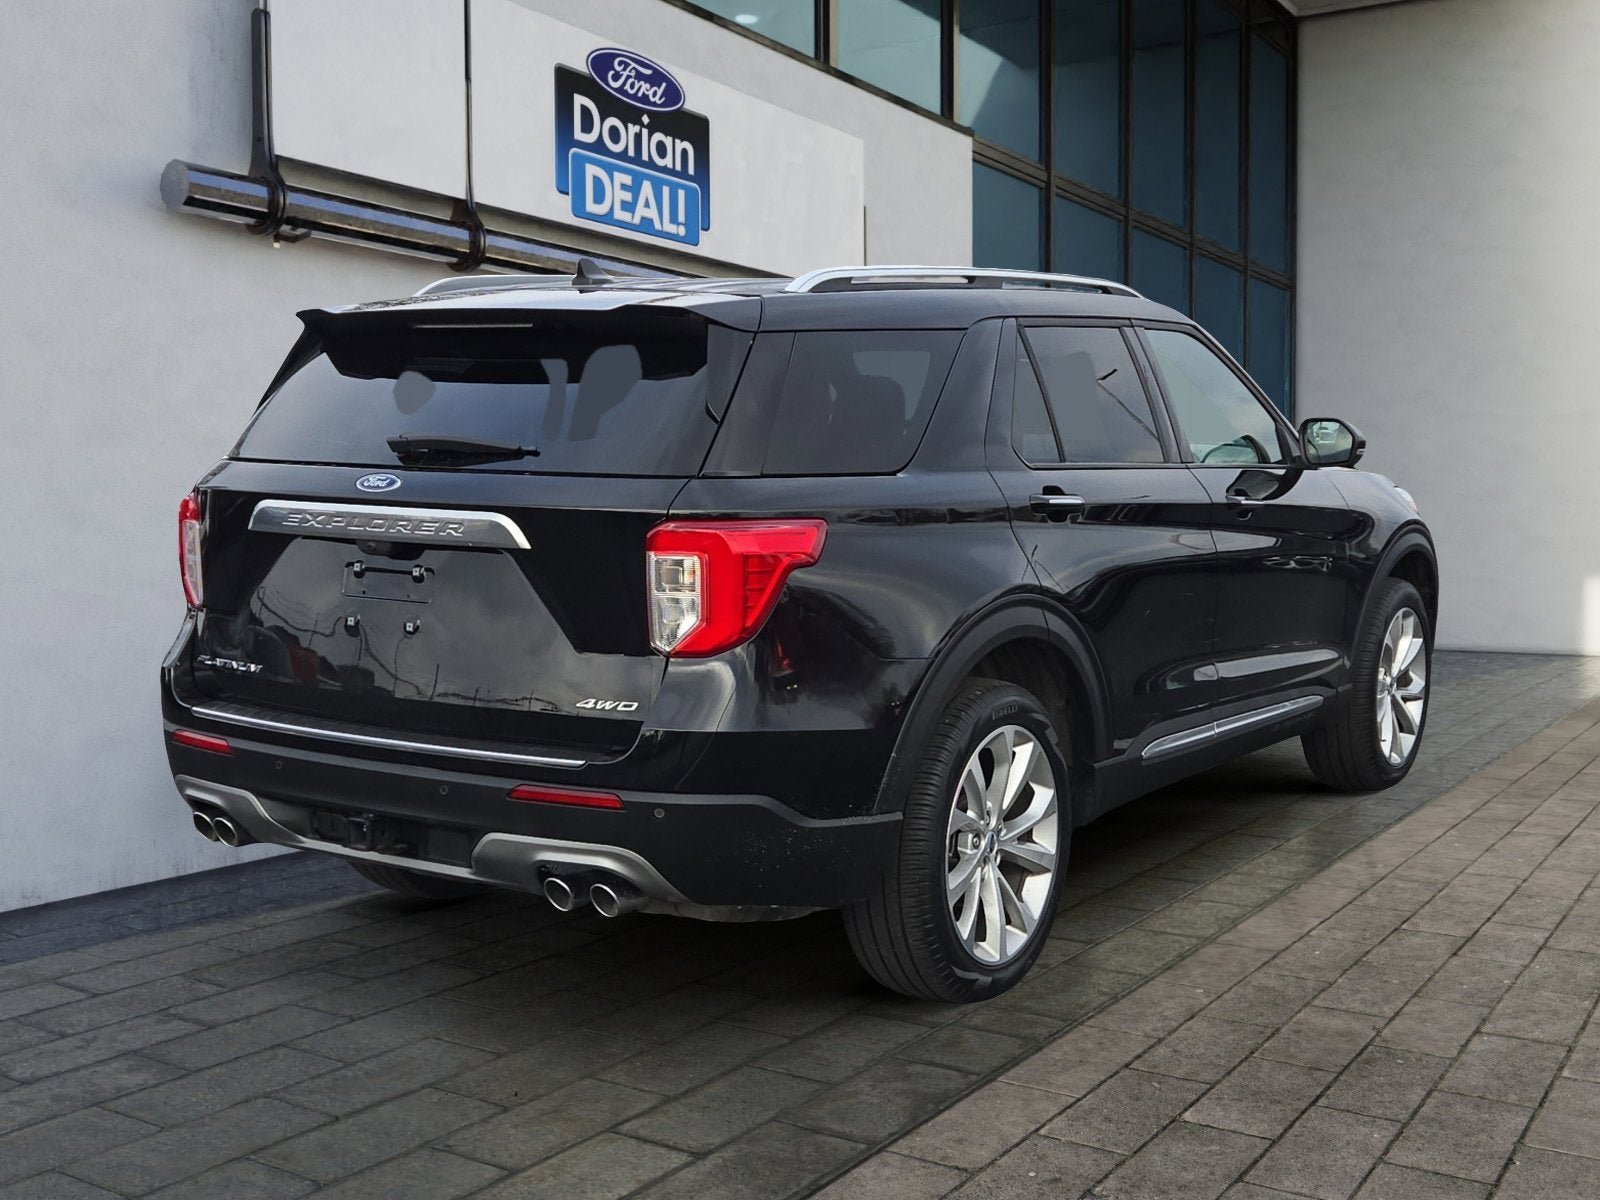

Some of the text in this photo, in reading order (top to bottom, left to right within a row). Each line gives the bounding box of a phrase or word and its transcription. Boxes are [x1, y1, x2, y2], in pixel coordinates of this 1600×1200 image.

[607, 57, 667, 105] Ford
[573, 92, 695, 176] Dorian
[585, 163, 686, 237] DEAL!
[282, 513, 465, 537] EXPLORER
[576, 698, 639, 711] 4WD
